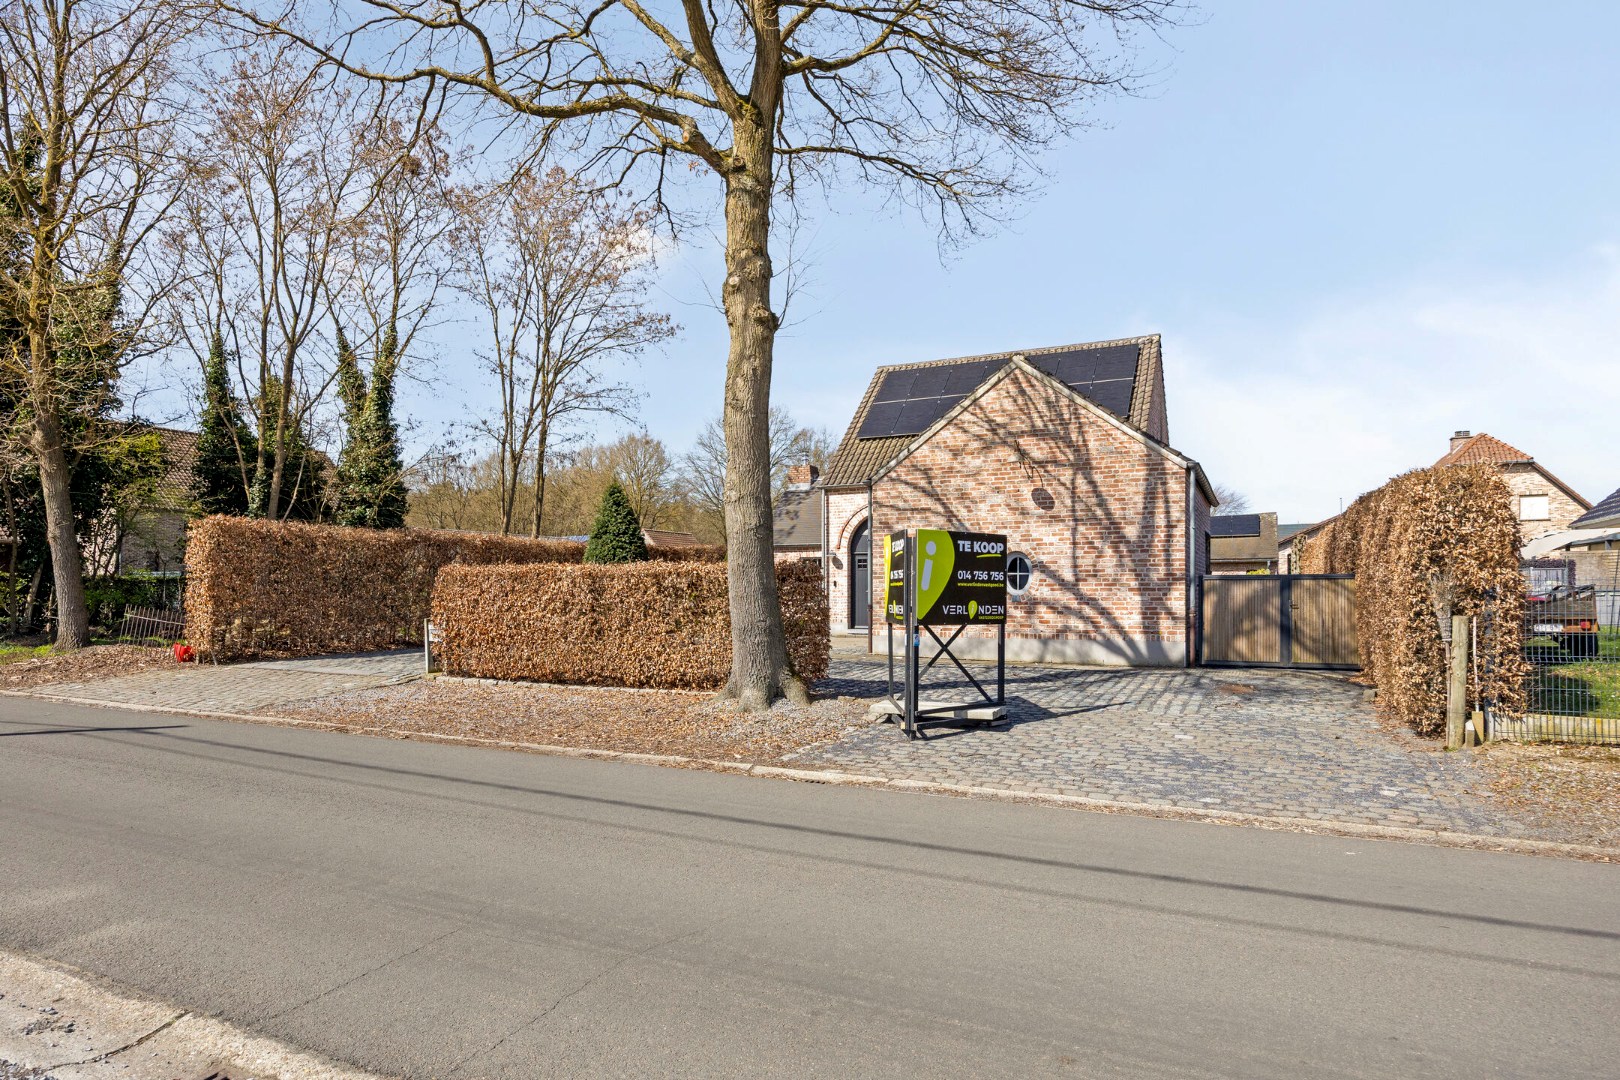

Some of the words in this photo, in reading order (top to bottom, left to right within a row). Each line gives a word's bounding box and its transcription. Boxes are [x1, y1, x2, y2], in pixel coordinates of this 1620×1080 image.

[958, 540, 971, 552] TE
[973, 541, 1004, 554] KOOP
[957, 570, 971, 580] 014
[974, 571, 988, 580] 756
[991, 571, 1004, 581] 756
